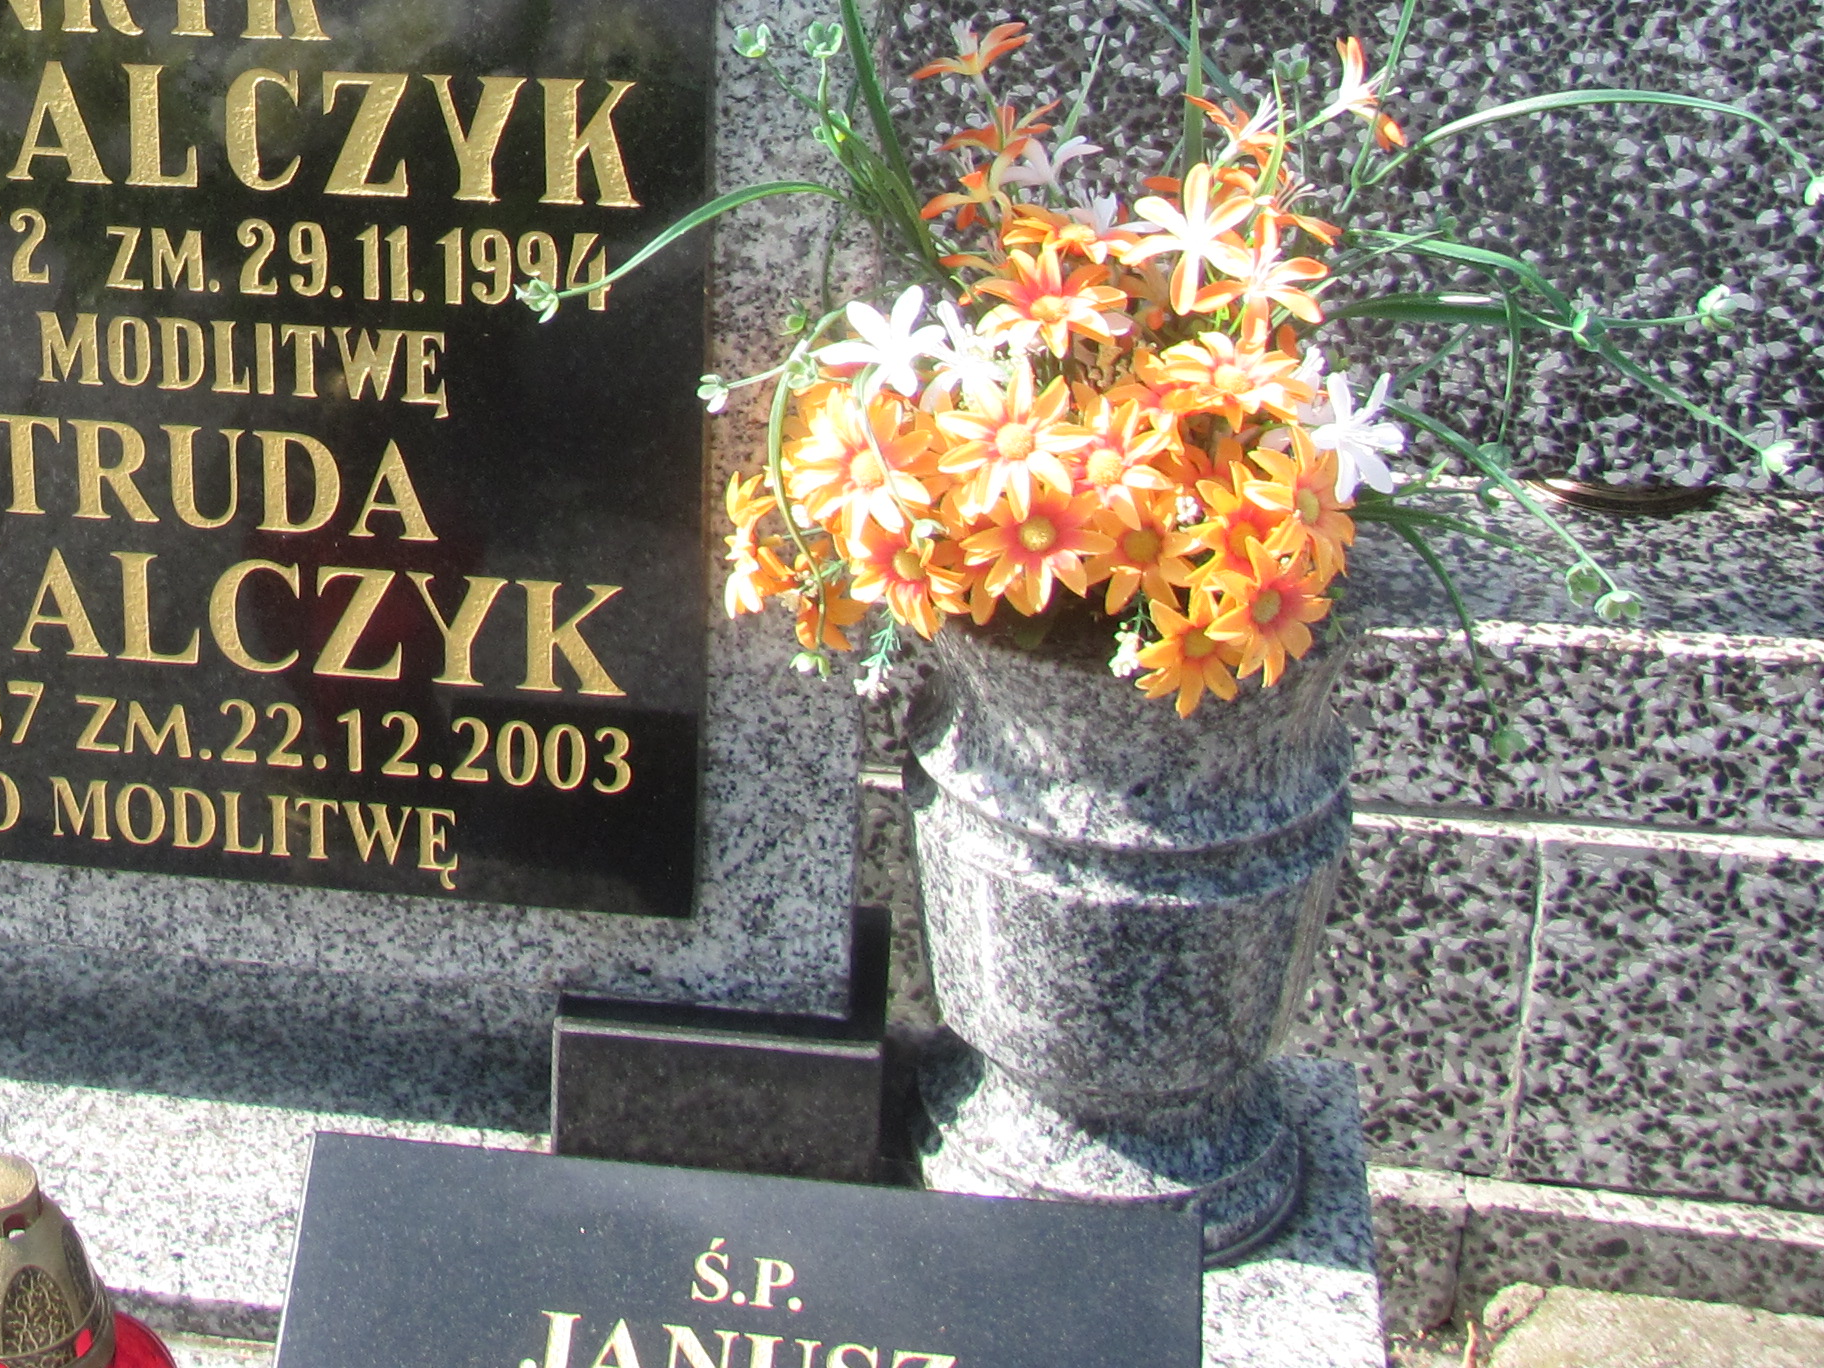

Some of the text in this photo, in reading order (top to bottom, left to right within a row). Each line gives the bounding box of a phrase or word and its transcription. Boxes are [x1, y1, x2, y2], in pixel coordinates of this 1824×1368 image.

[34, 309, 450, 420] MODLITWĘ
[48, 775, 460, 890] MODLITWĘ
[690, 1236, 804, 1313] Ś.P.
[516, 1309, 959, 1368] JAN
